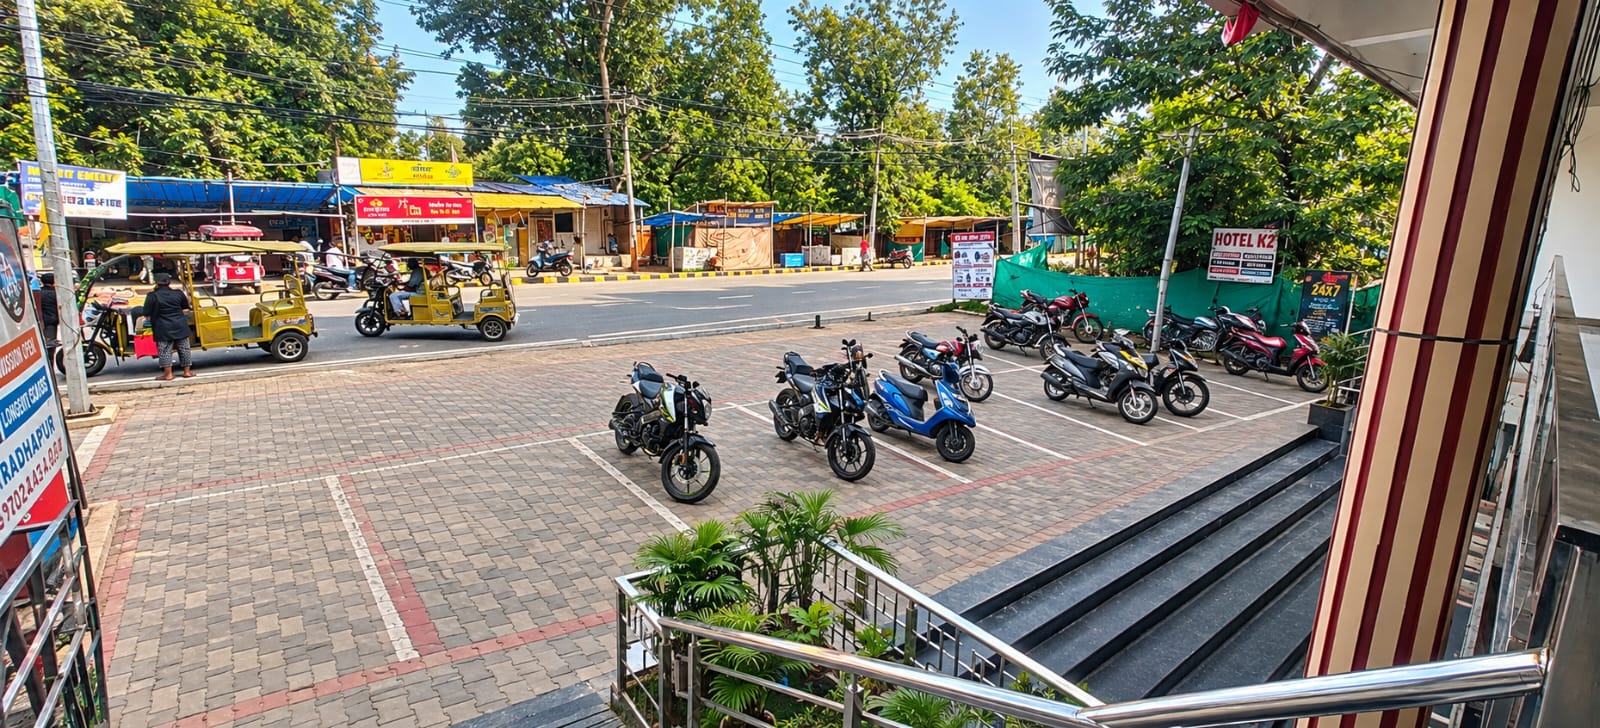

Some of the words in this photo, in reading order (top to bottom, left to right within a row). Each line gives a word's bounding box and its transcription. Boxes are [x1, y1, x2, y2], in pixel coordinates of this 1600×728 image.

[1214, 232, 1254, 247] HOTEL
[1257, 233, 1276, 249] K2
[1310, 283, 1342, 298] 24X7
[0, 415, 56, 490] RADHAPUR
